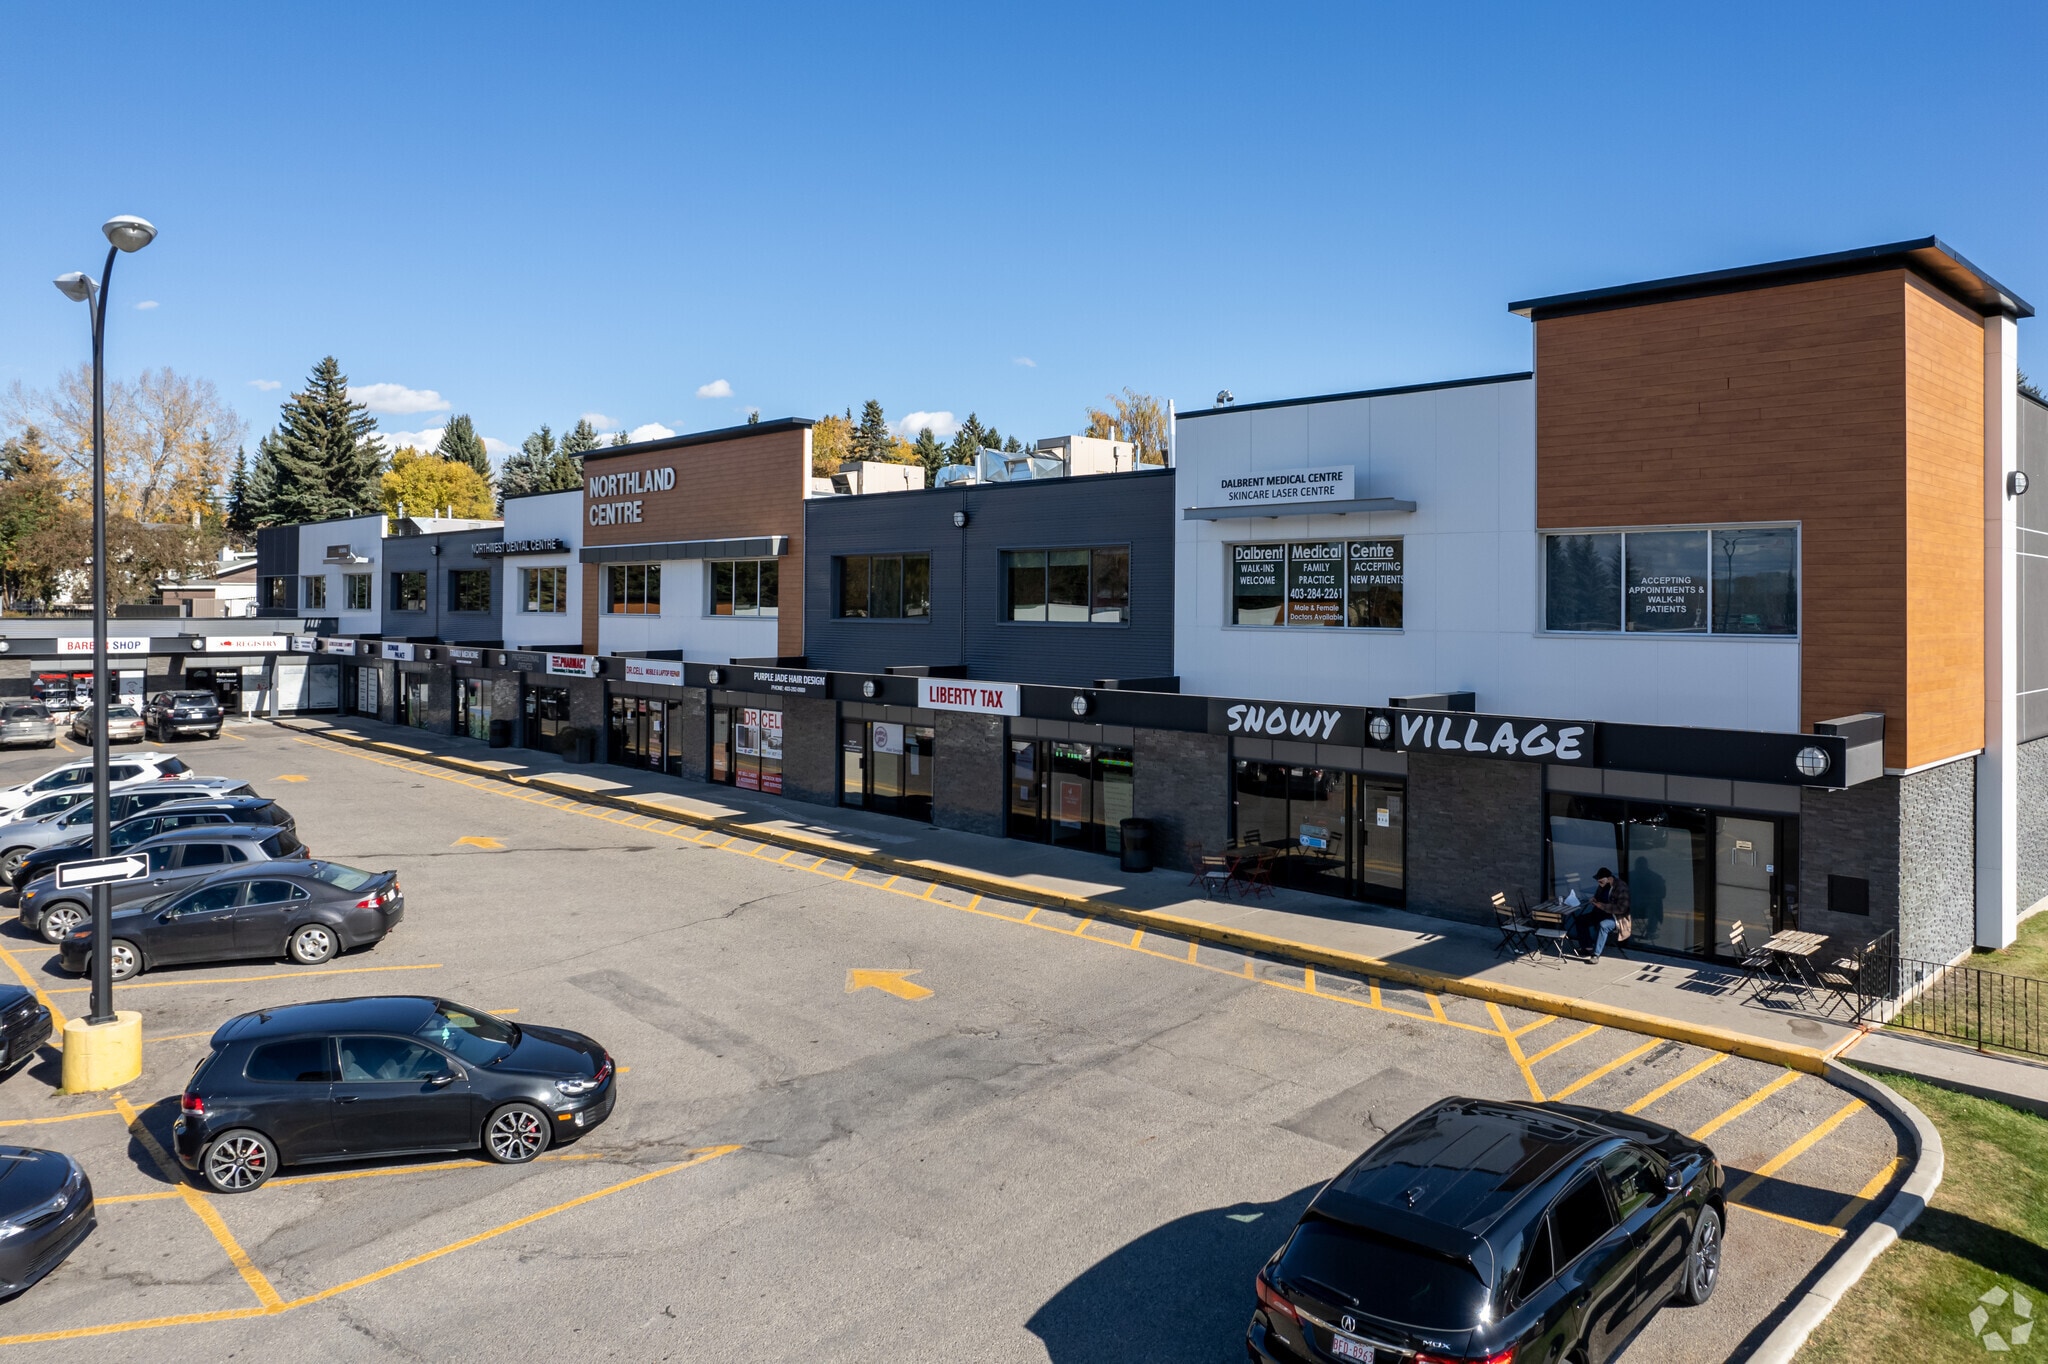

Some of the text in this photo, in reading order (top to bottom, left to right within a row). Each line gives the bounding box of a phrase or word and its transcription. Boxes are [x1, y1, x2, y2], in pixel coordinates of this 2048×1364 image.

[589, 467, 676, 498] NORTHLAND
[1221, 471, 1343, 489] DALBRENT MEDICAL CENTRE
[1228, 485, 1335, 501] SKINCARE LASER CENTRE
[589, 500, 643, 526] CENTRE
[471, 538, 556, 554] NORTHWEST DENTAL CENTRE
[1235, 543, 1394, 560] Dalbrent Medical Centre
[1240, 563, 1275, 573] WALK-INS
[1303, 562, 1330, 572] FAMILY
[1354, 561, 1401, 572] ACCEPTING
[1240, 575, 1275, 585] WELCOME
[1298, 575, 1335, 584] PRACTICE
[1350, 575, 1404, 584] NEW PATIENTS
[1641, 576, 1692, 585] ACCEPTING
[1290, 588, 1343, 600] 403-284-2261
[1628, 585, 1705, 594] APPOINTMENTS &
[1647, 595, 1685, 604] WALK-IN
[1293, 604, 1340, 612] Male & Female
[1645, 605, 1687, 613] PATIENTS
[1290, 613, 1343, 621] Doctors Available
[67, 640, 141, 650] BARB SHOP
[560, 657, 587, 669] PHARMACY
[753, 672, 825, 685] PURPLE JADE HAIR DESIGN
[929, 685, 1003, 709] LIBERTY TAX
[744, 710, 759, 726] DR.
[1226, 703, 1342, 741] SNOWY
[1400, 713, 1585, 760] VILLAGE
[1422, 1340, 1451, 1350] MDX
